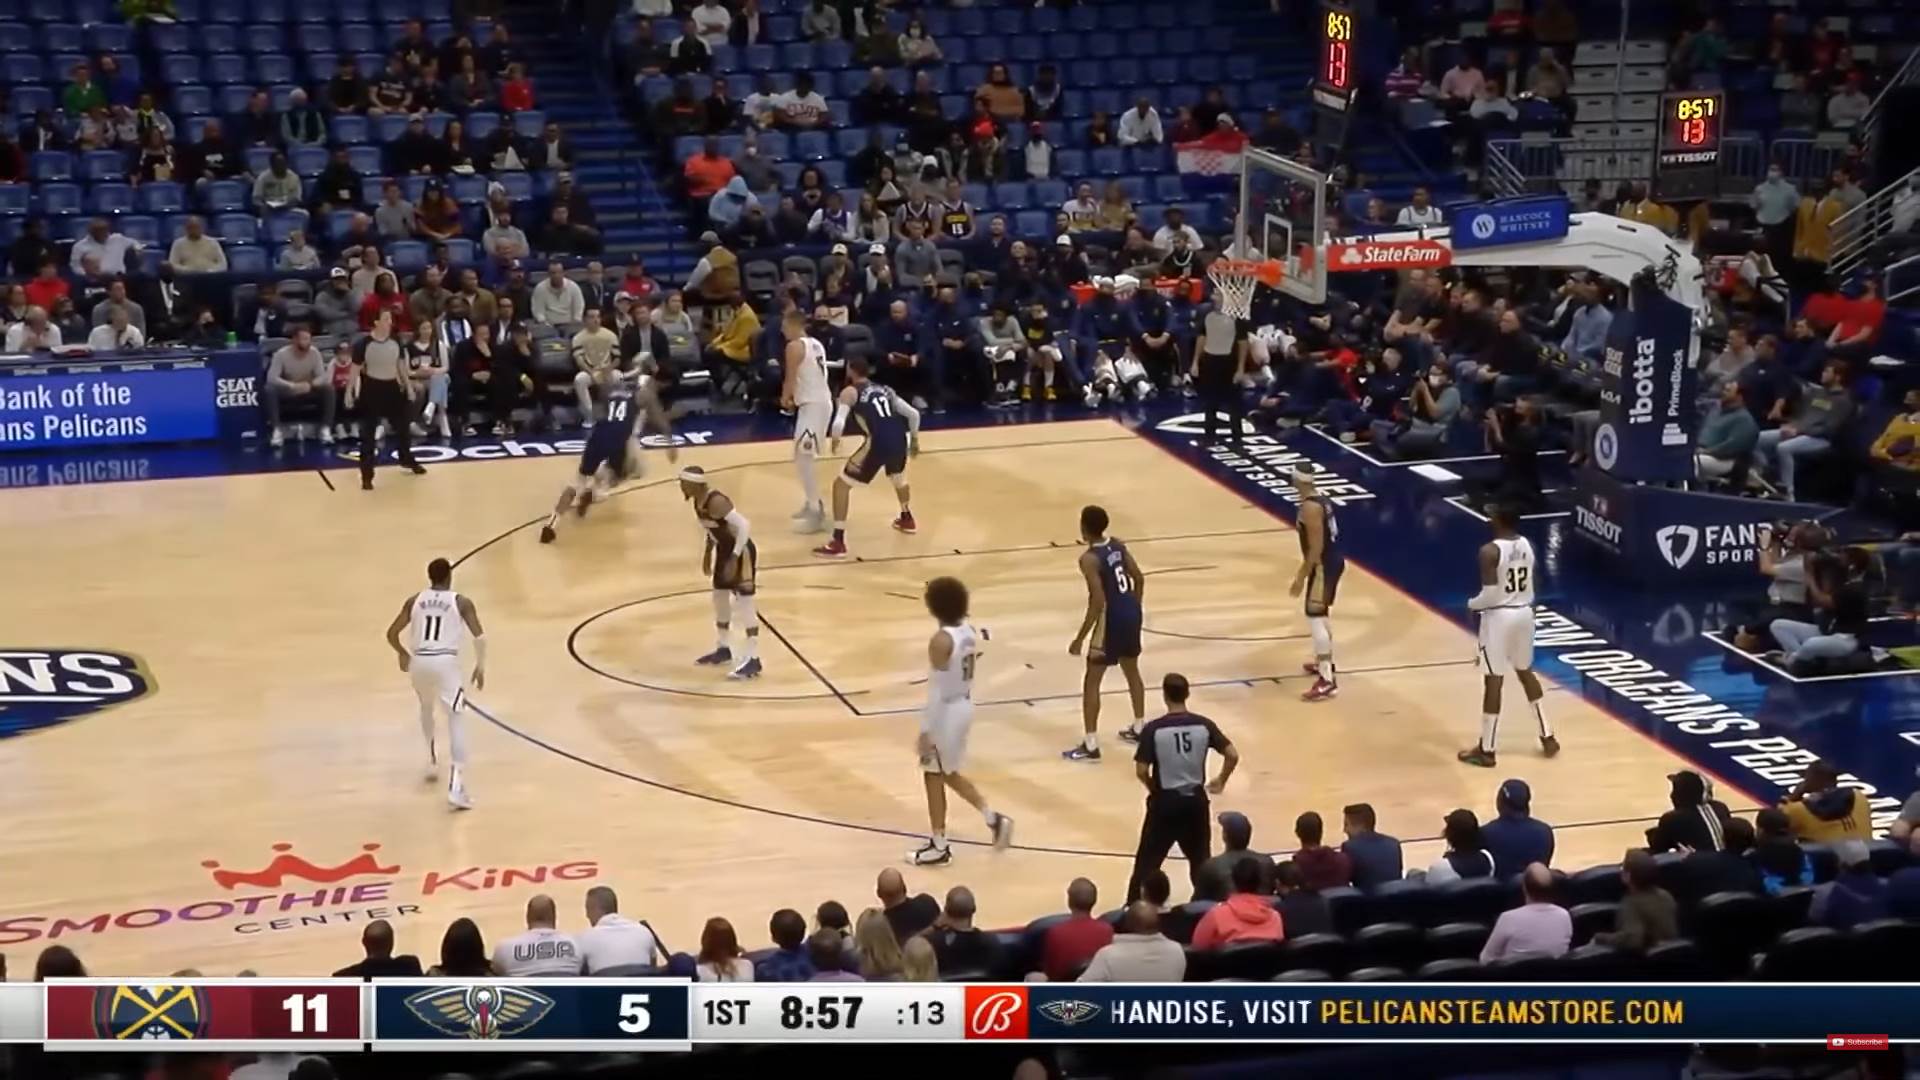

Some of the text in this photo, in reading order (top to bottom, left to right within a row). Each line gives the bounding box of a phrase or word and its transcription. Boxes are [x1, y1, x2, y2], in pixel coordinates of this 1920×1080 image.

[1328, 42, 1347, 87] 13
[1678, 98, 1714, 120] 8:57
[1682, 118, 1705, 145] 13
[1677, 151, 1717, 163] TISSOT
[217, 377, 256, 394] SEAT
[1629, 338, 1655, 424] ibotta
[1667, 349, 1683, 416] PrimeBlock
[61, 382, 85, 408] of
[92, 382, 131, 407] the
[216, 391, 259, 408] GEEK
[872, 396, 891, 418] 17
[608, 400, 627, 421] 14
[43, 413, 147, 440] Pelicans
[391, 431, 713, 462] Ochser
[1189, 438, 1302, 506] PORTSBOO
[1576, 505, 1622, 544] TISSOT
[1706, 547, 1770, 564] SPOR
[1505, 567, 1528, 593] 32
[424, 614, 442, 641] 11
[1558, 650, 1760, 735] ORLEANS
[1173, 732, 1192, 754] 15
[0, 882, 394, 944] SMOOTHIE
[234, 904, 423, 934] CENTER
[513, 941, 577, 962] USA
